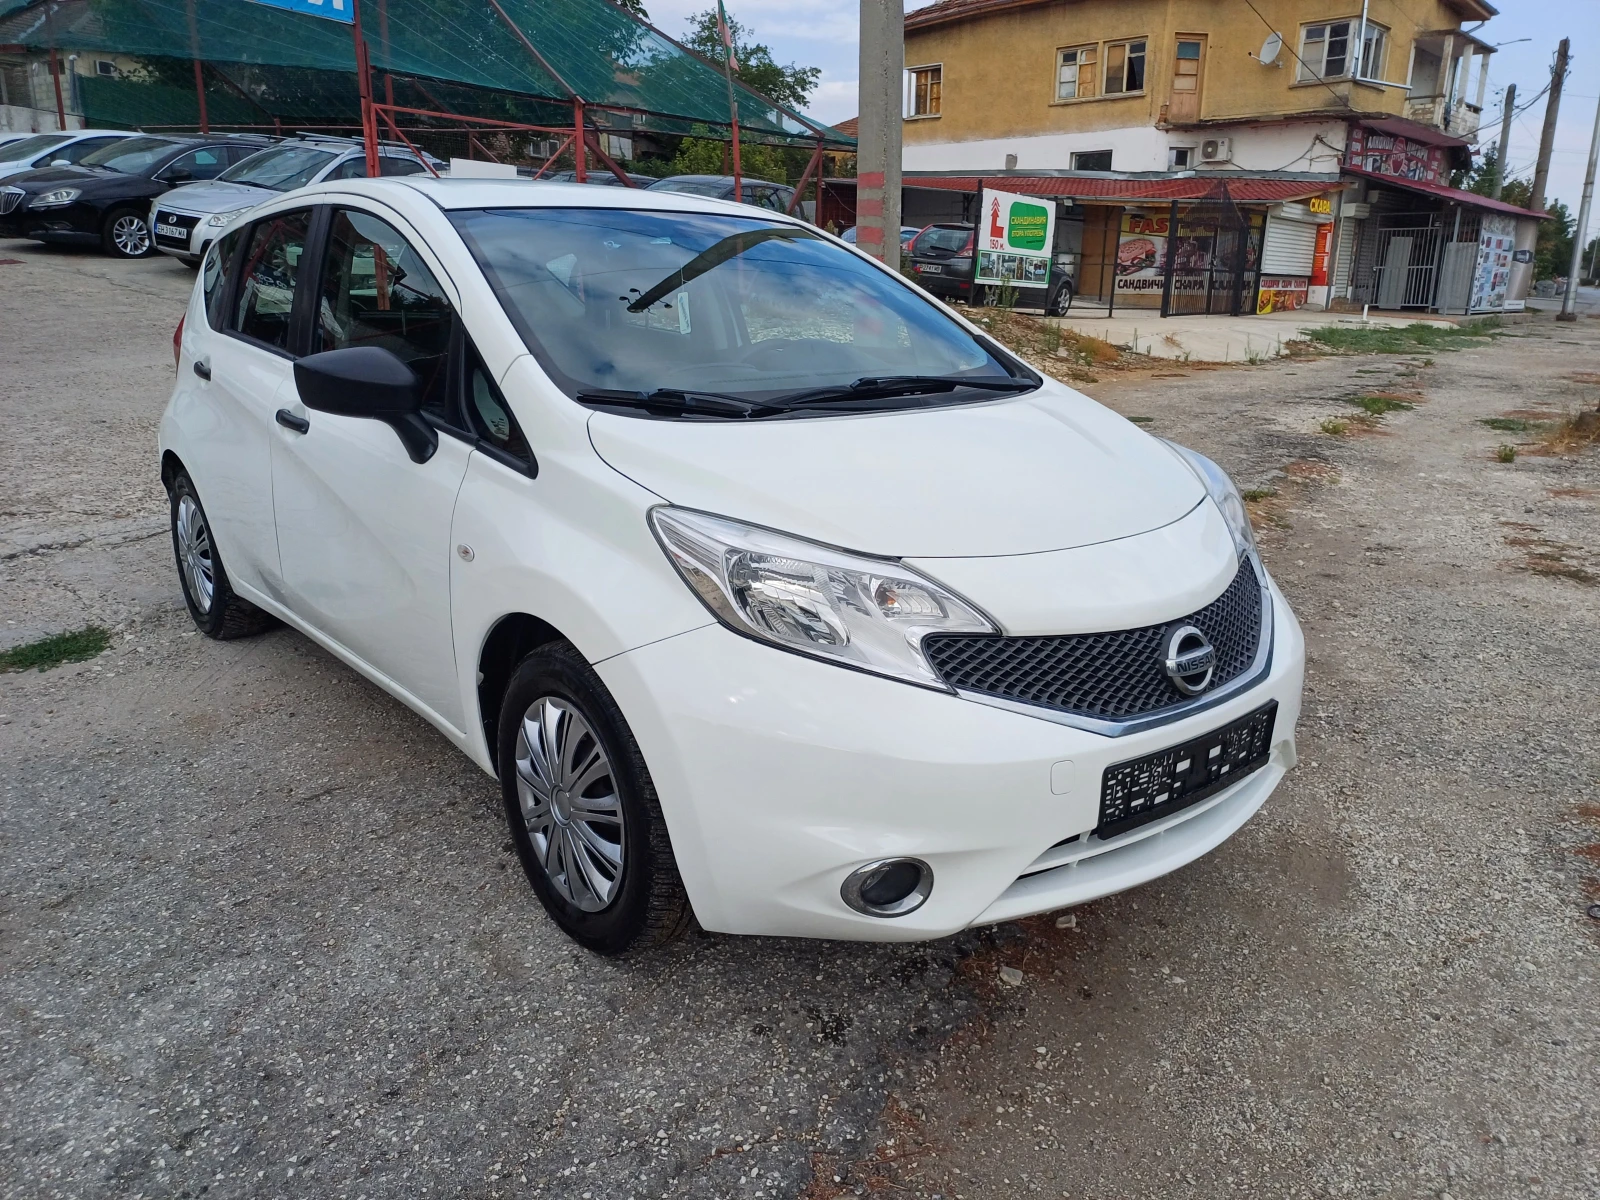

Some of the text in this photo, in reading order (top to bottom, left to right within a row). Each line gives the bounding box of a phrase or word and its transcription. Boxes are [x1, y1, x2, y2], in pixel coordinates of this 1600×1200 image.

[1310, 198, 1330, 214] СКАРА
[990, 239, 999, 249] 150
[1177, 654, 1213, 673] NISSAN
